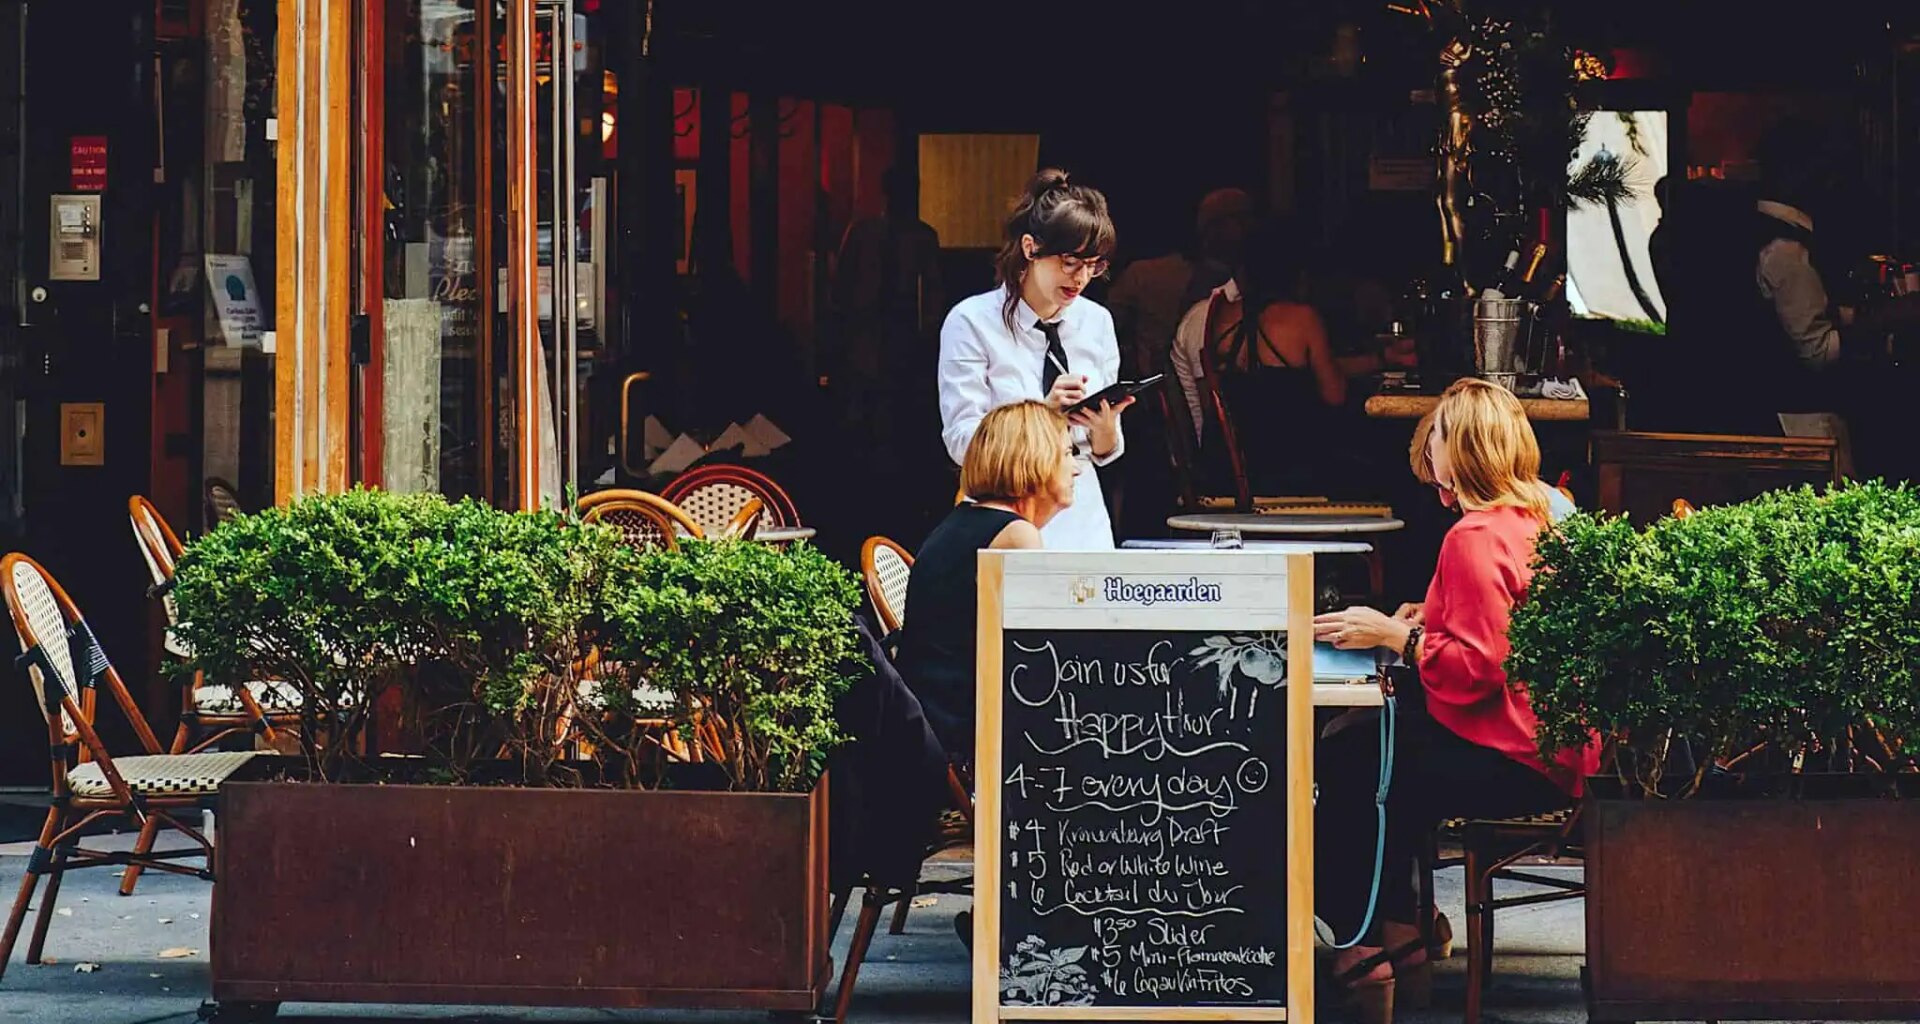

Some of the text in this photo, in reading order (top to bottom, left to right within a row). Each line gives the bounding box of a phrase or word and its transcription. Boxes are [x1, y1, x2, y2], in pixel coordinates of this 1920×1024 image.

[1104, 576, 1222, 605] Hoegaarden
[1010, 640, 1103, 706] Join
[1054, 689, 1166, 761] Happy
[1166, 815, 1231, 847] Draft
[1060, 848, 1094, 878] Red
[1097, 860, 1118, 876] or
[1119, 852, 1171, 876] White
[1174, 853, 1230, 877] Wine
[1064, 878, 1140, 904] Cocktail
[1180, 878, 1245, 910] Jour
[1147, 917, 1216, 946] Slider
